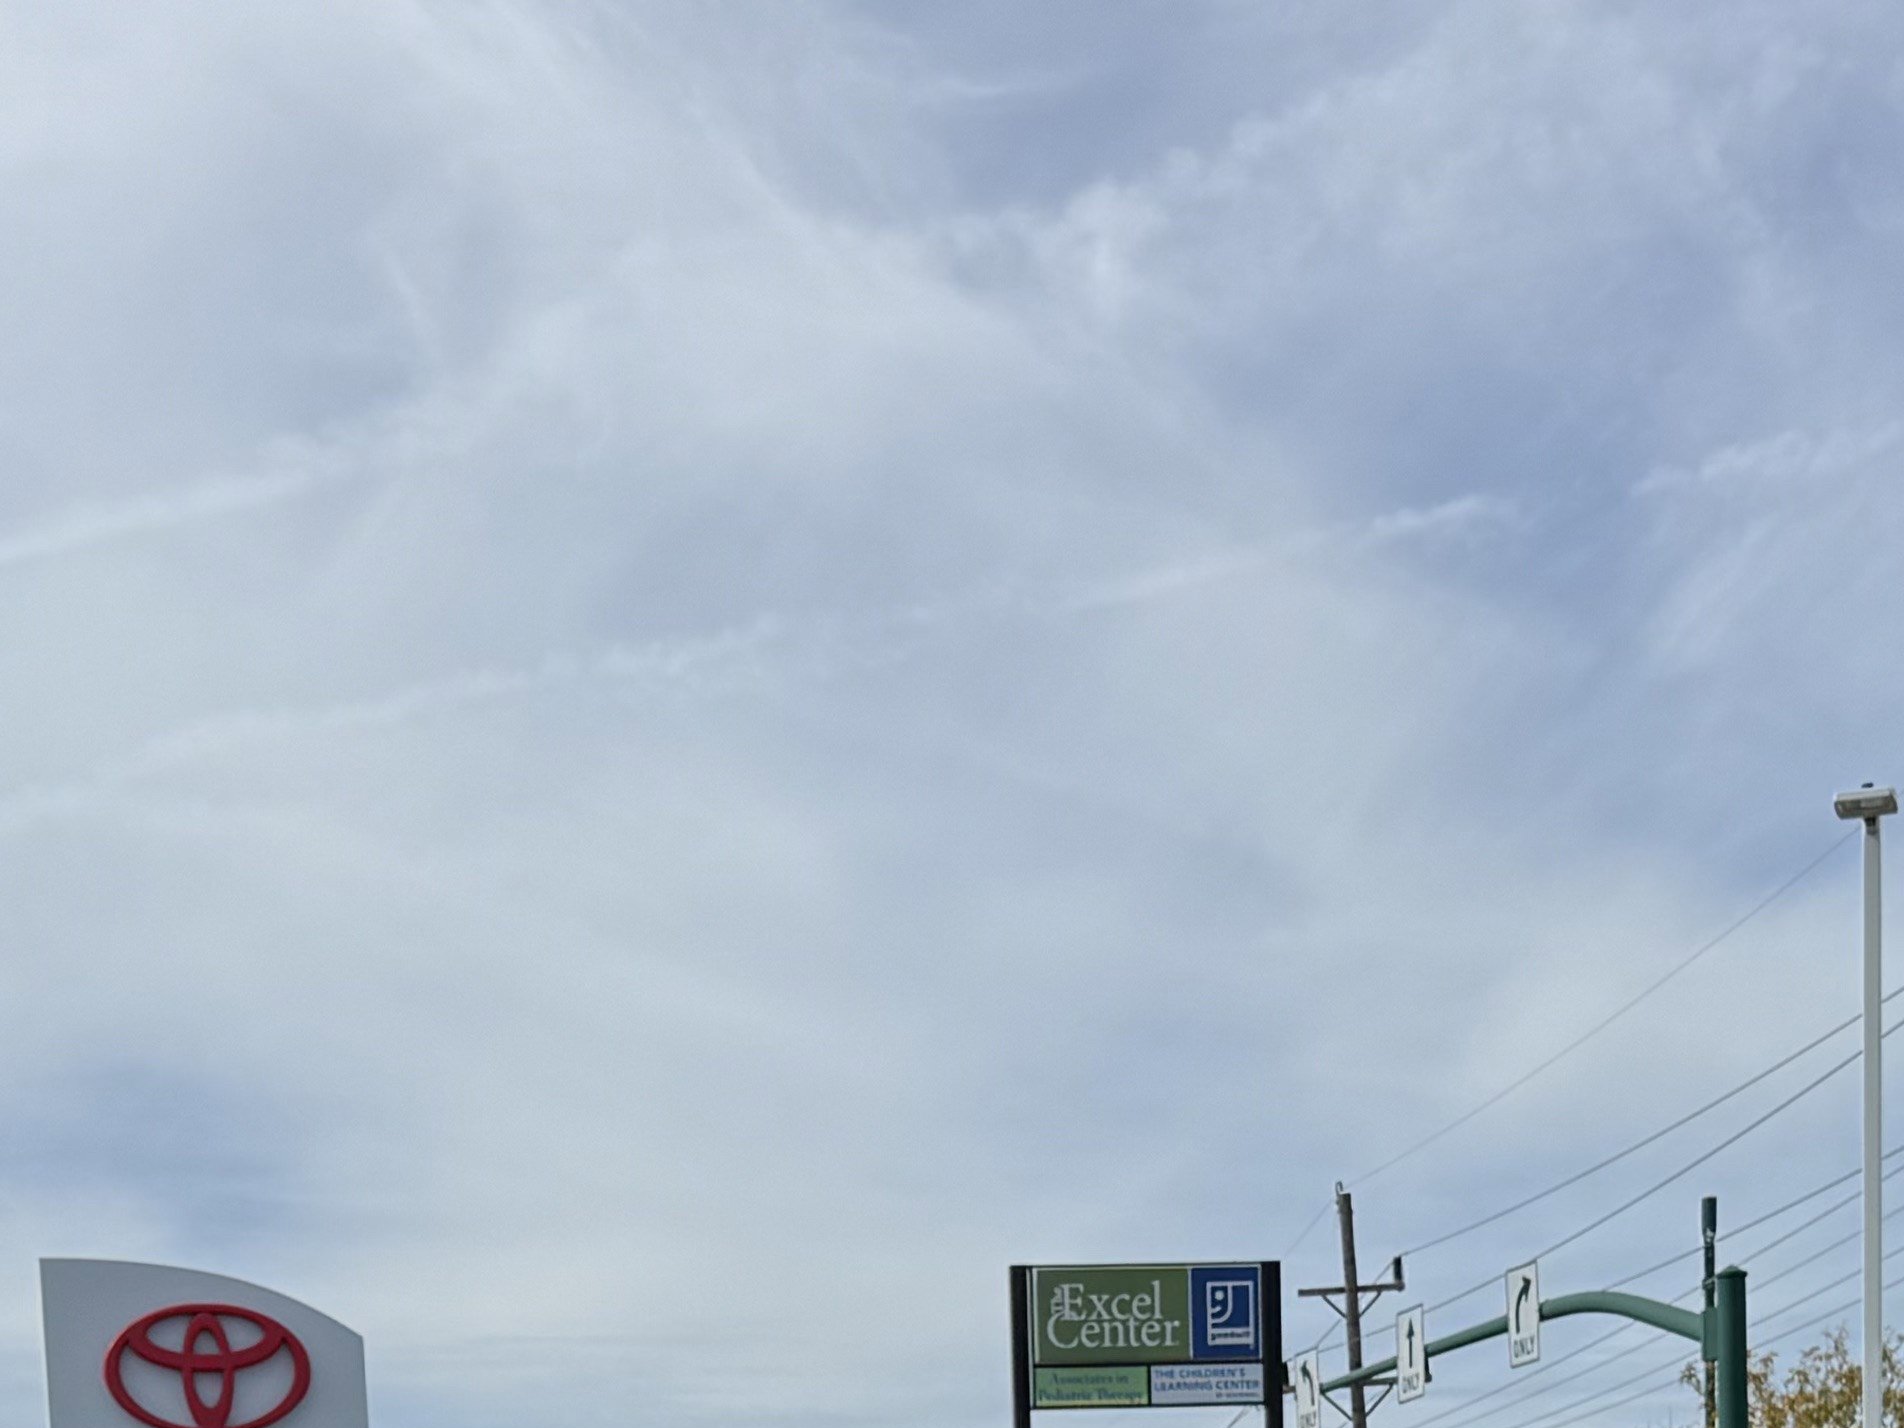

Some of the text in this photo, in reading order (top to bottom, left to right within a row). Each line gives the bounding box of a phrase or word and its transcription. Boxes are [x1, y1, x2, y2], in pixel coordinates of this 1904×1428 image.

[1059, 1280, 1163, 1321] Excel
[1047, 1312, 1180, 1349] Center
[1512, 1336, 1535, 1358] ONLY
[1154, 1369, 1174, 1379] THE
[1402, 1372, 1420, 1394] ONLY
[1154, 1379, 1259, 1392] LEARNING CENTER
